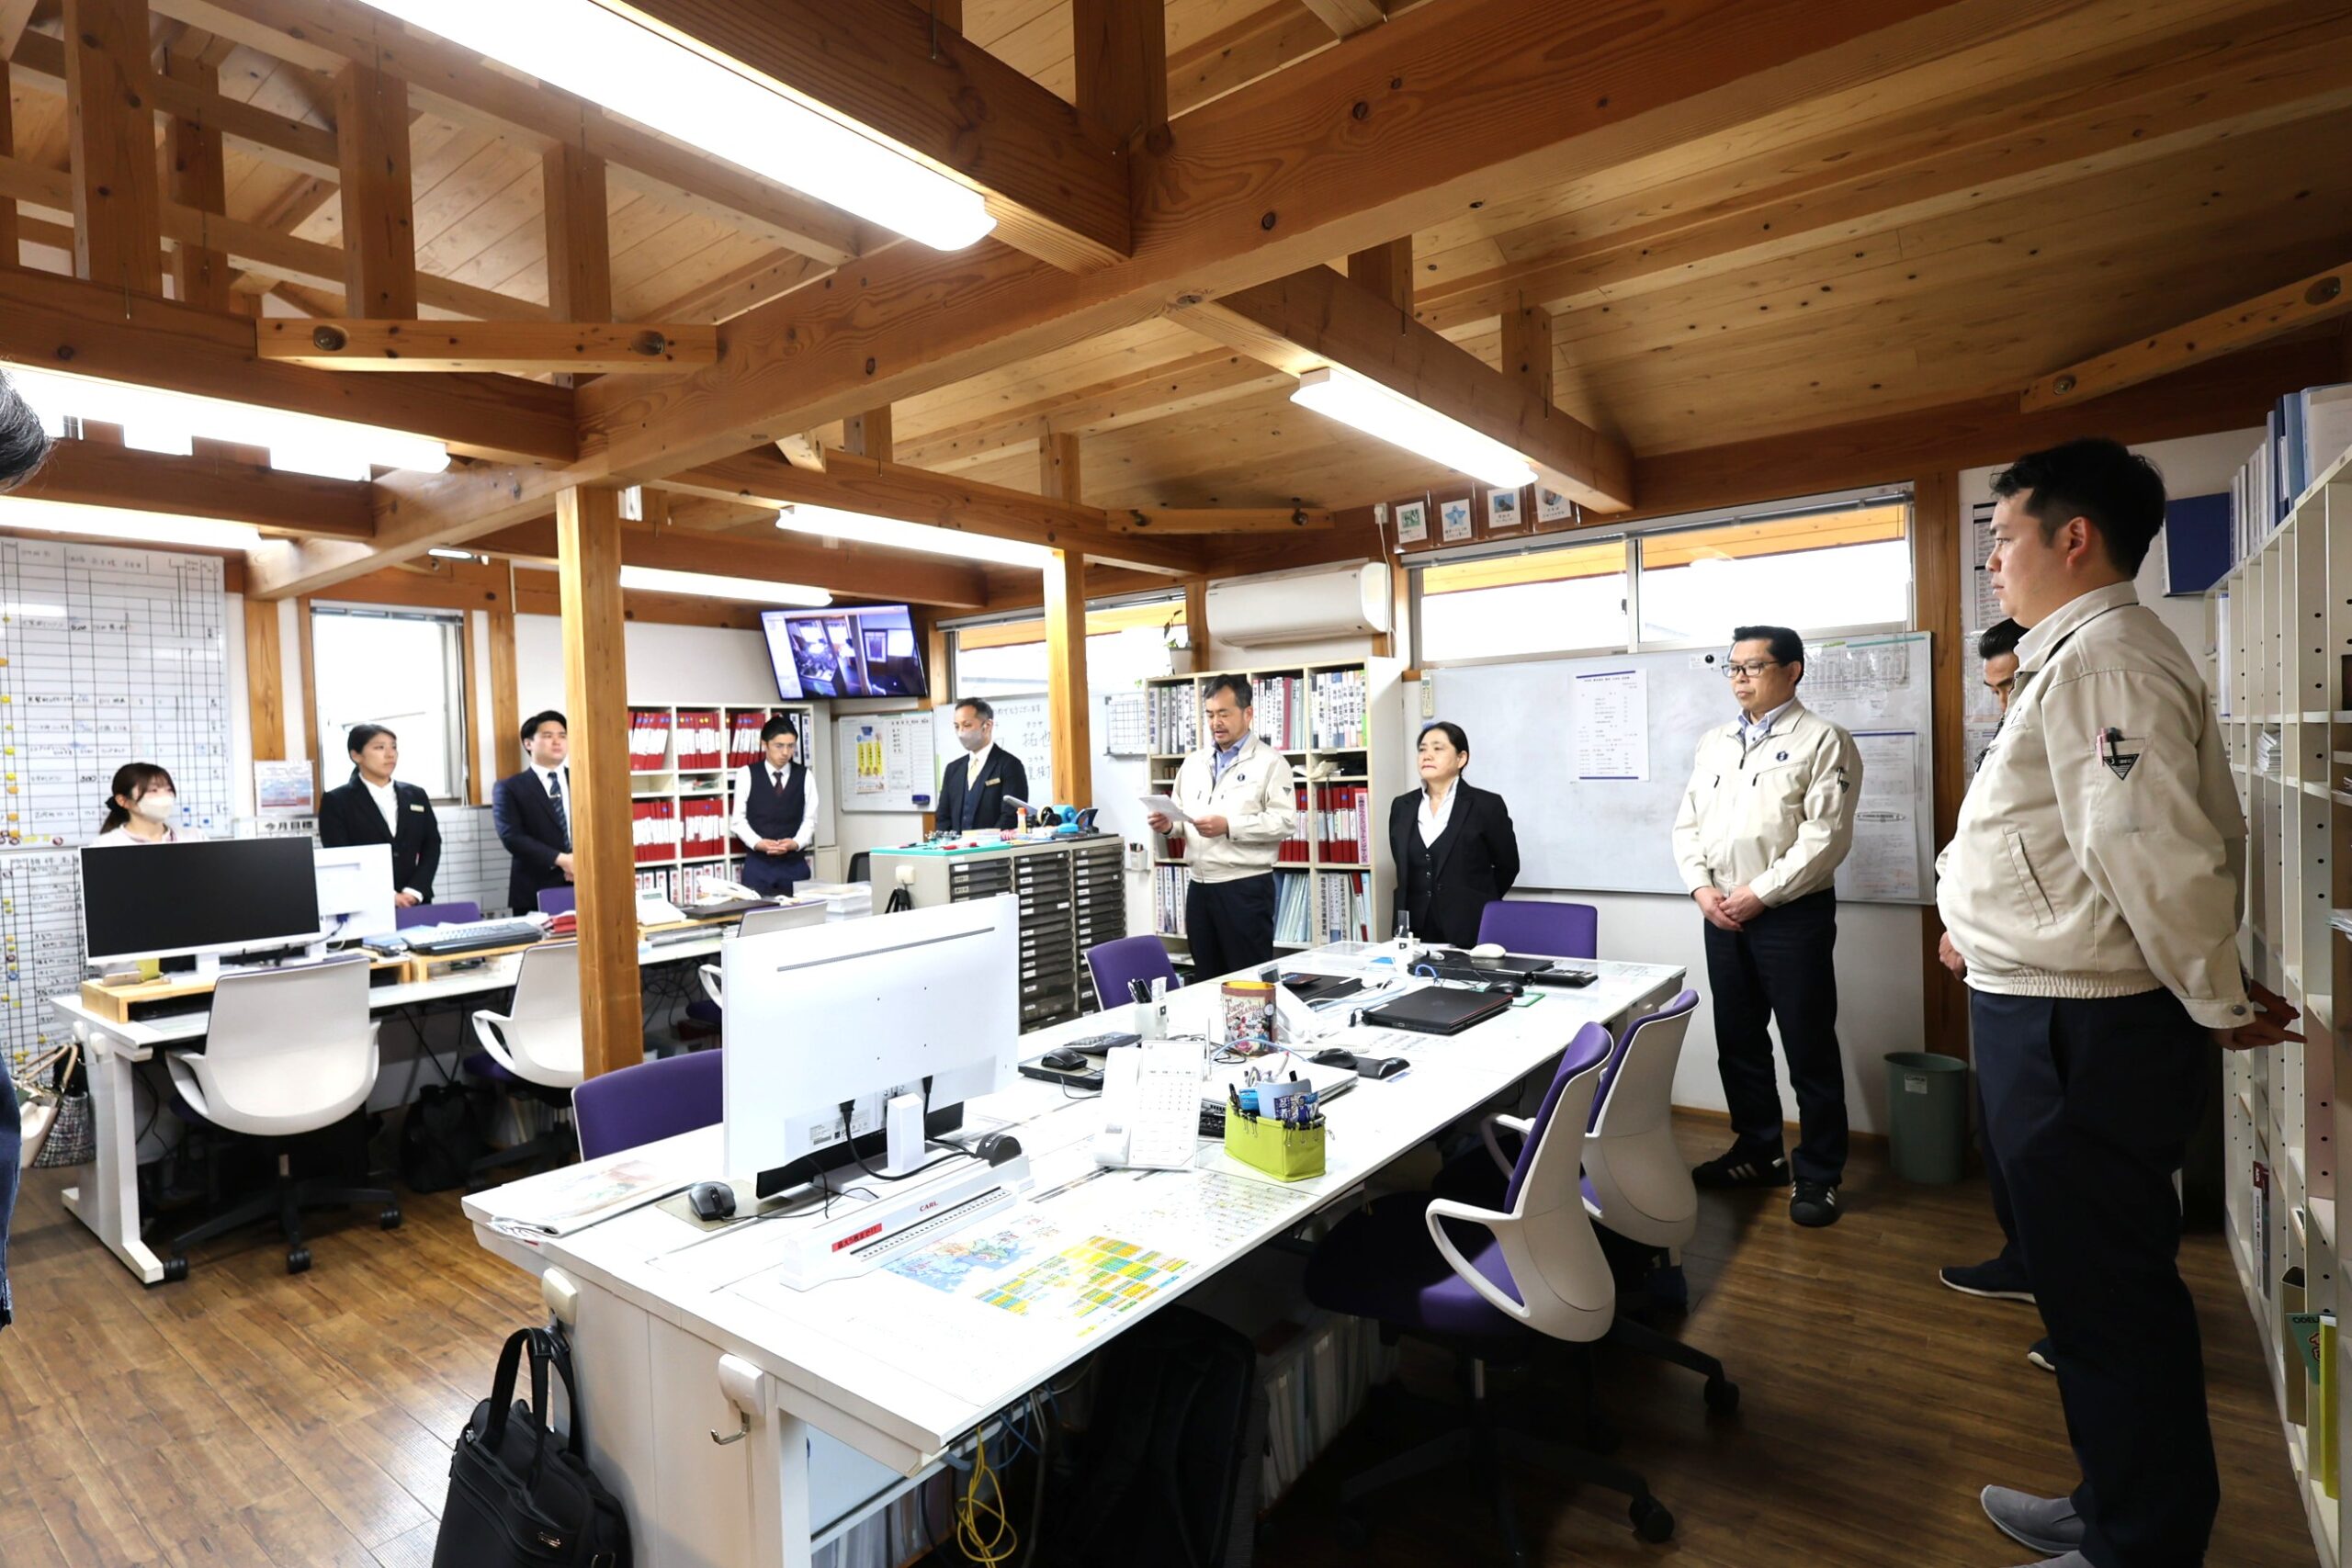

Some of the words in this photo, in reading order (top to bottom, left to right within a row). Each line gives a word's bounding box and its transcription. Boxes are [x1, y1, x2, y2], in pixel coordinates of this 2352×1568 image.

[265, 820, 313, 831] 今月目標
[919, 1201, 938, 1213] CARL
